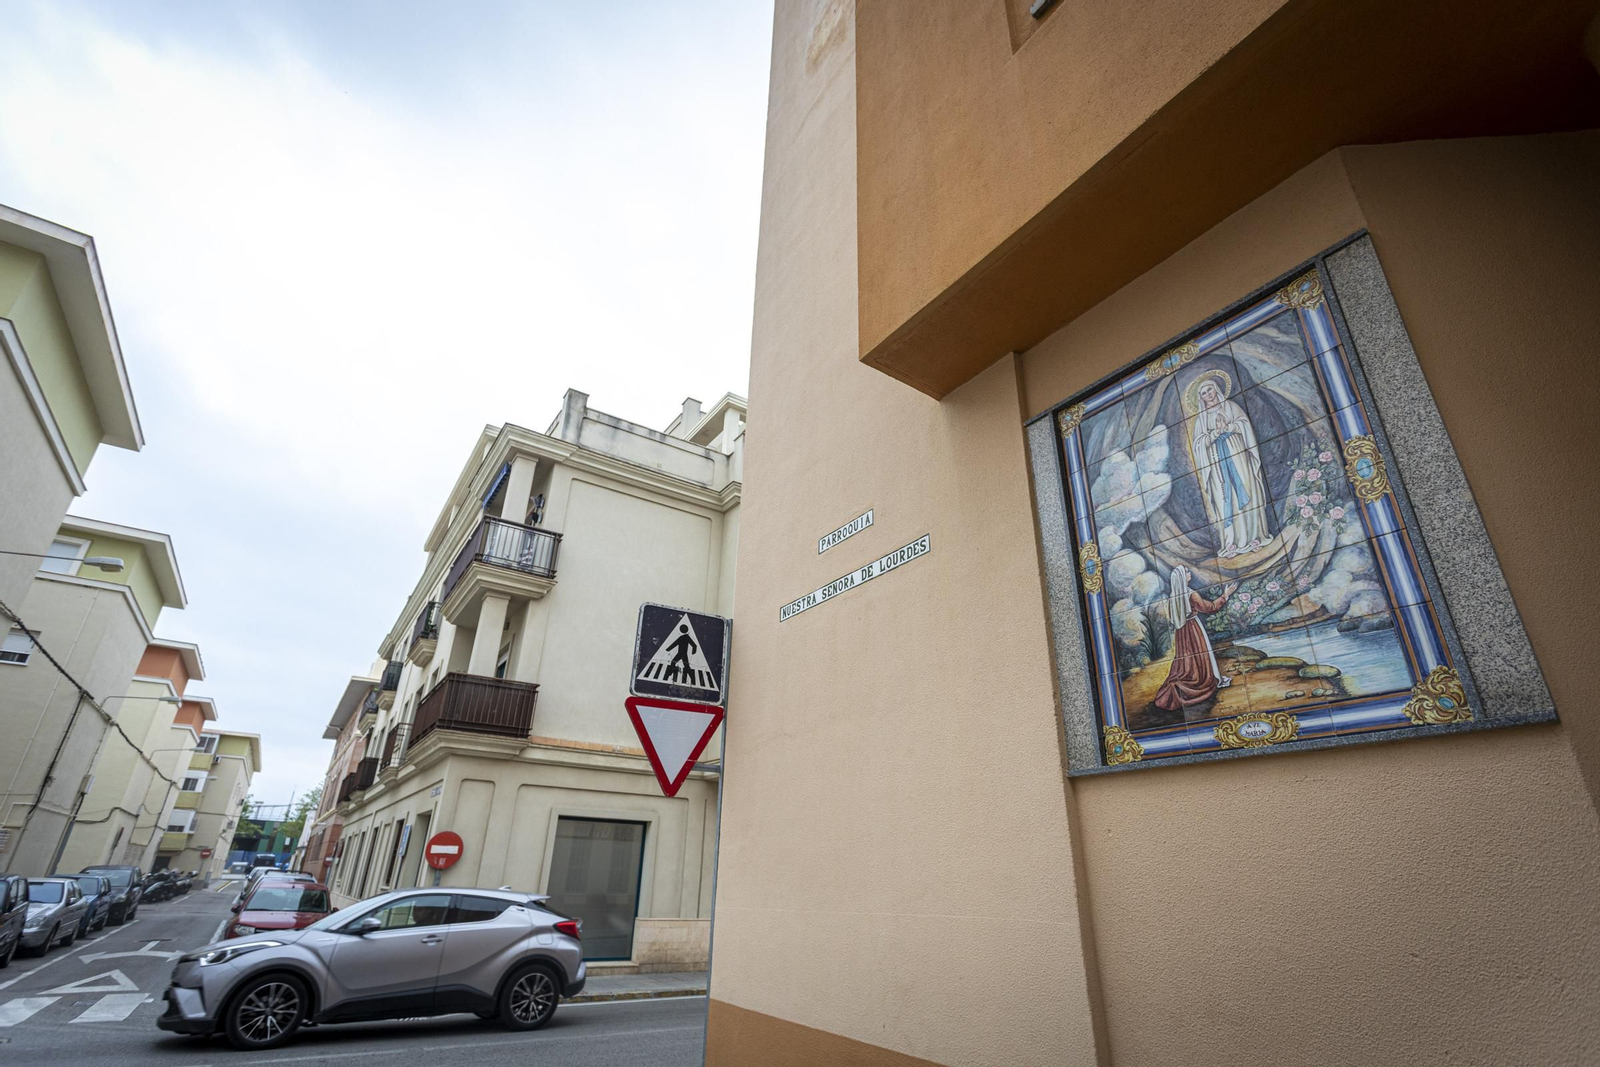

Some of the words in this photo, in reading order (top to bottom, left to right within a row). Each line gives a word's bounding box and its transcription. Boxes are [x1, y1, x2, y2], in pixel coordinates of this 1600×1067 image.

[821, 513, 871, 550] PARROQUIA
[782, 593, 817, 619] NUESTRA
[861, 565, 873, 581] DE
[879, 539, 927, 572] LOURDES
